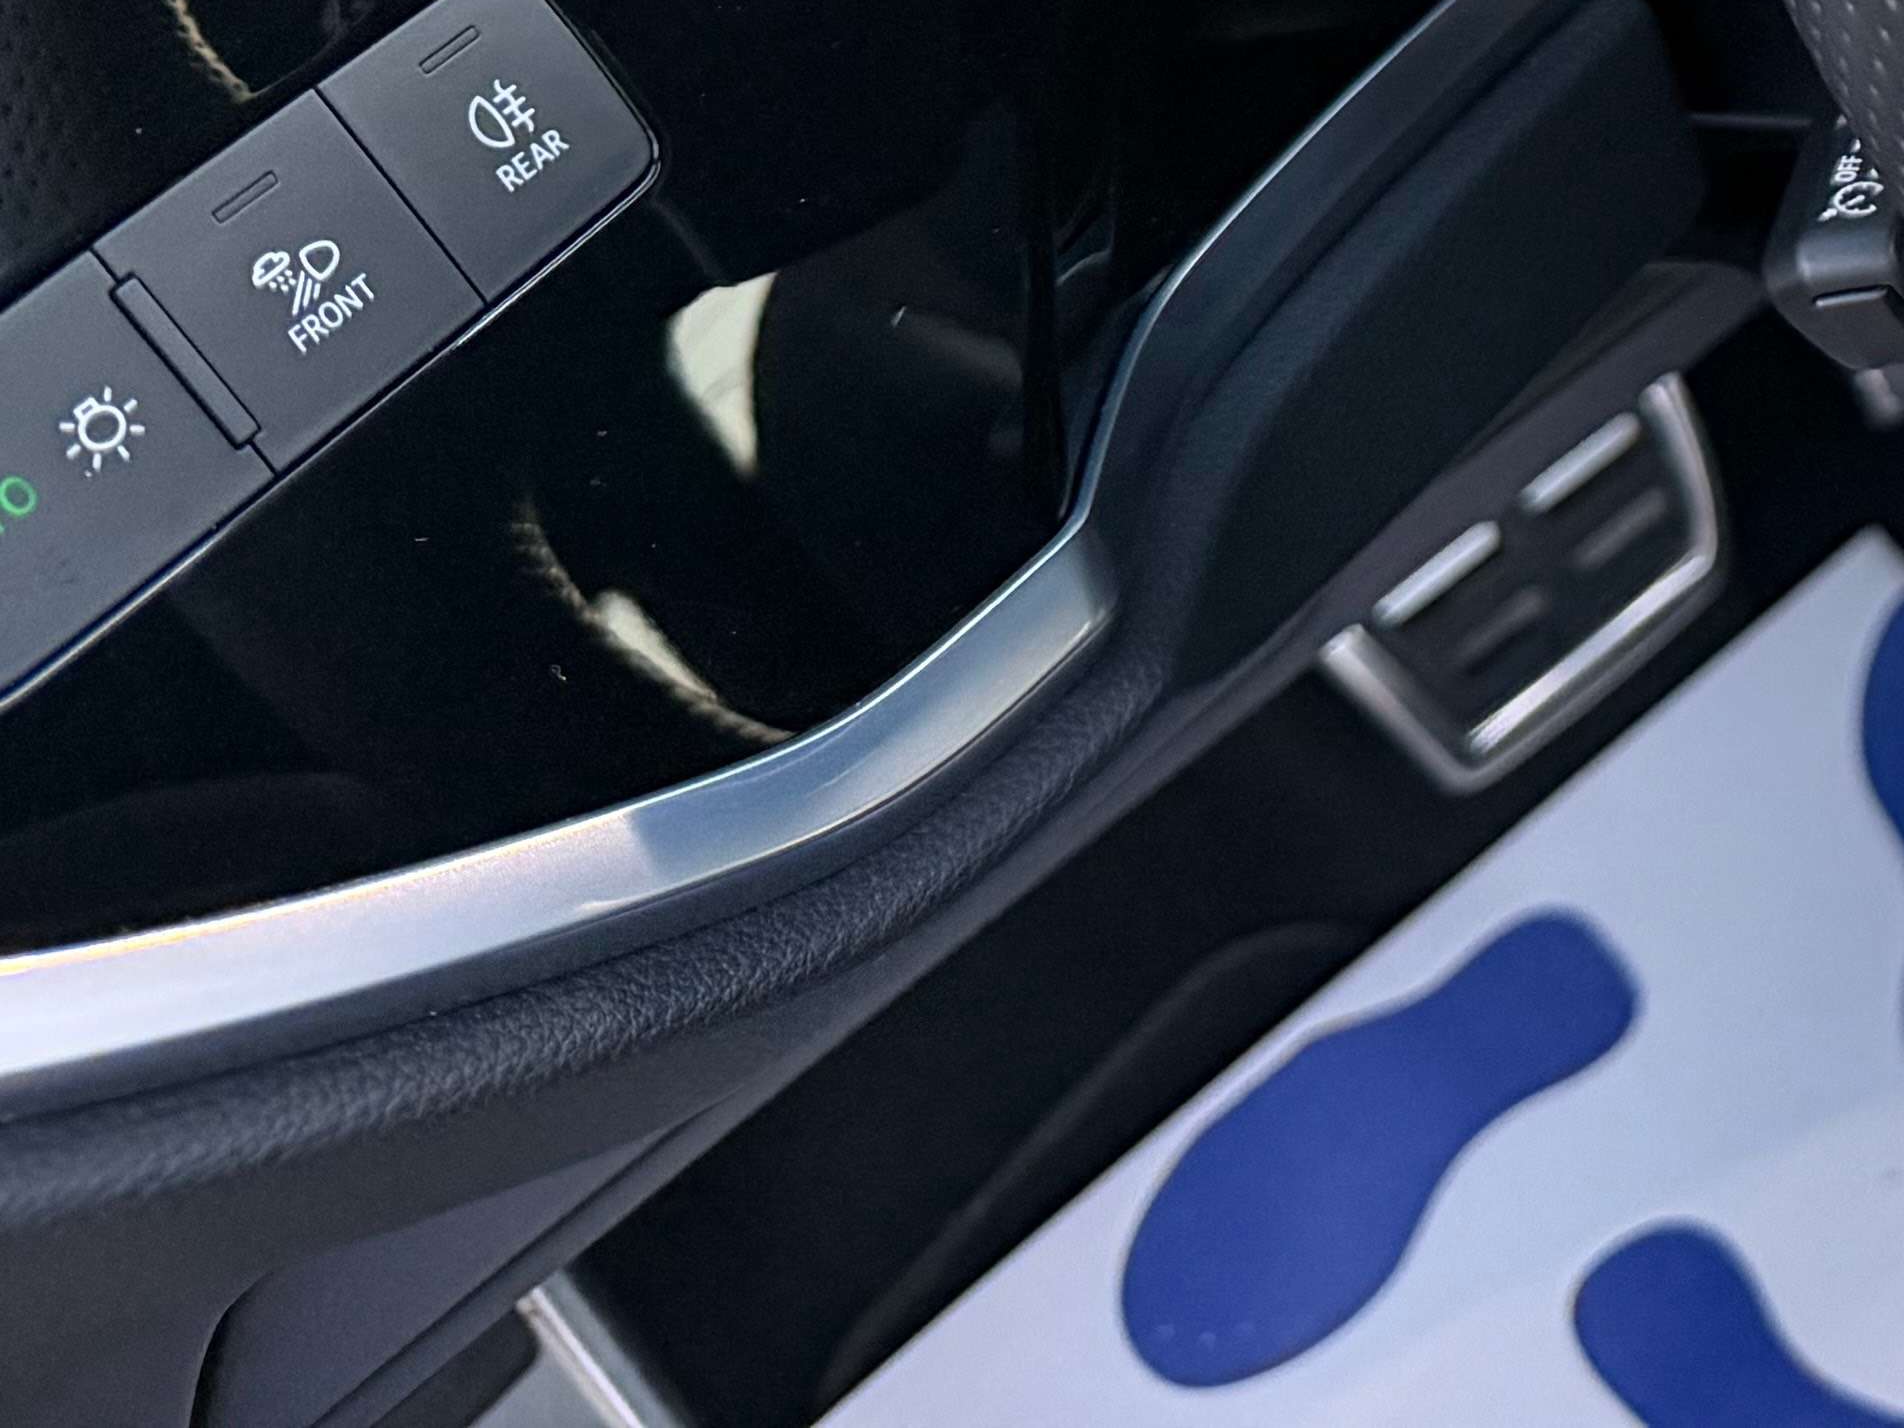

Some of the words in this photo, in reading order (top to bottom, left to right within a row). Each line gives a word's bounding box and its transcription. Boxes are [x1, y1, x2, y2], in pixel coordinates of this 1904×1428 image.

[495, 127, 571, 193] REAR
[1833, 154, 1863, 183] OFF
[287, 272, 375, 355] FRONT
